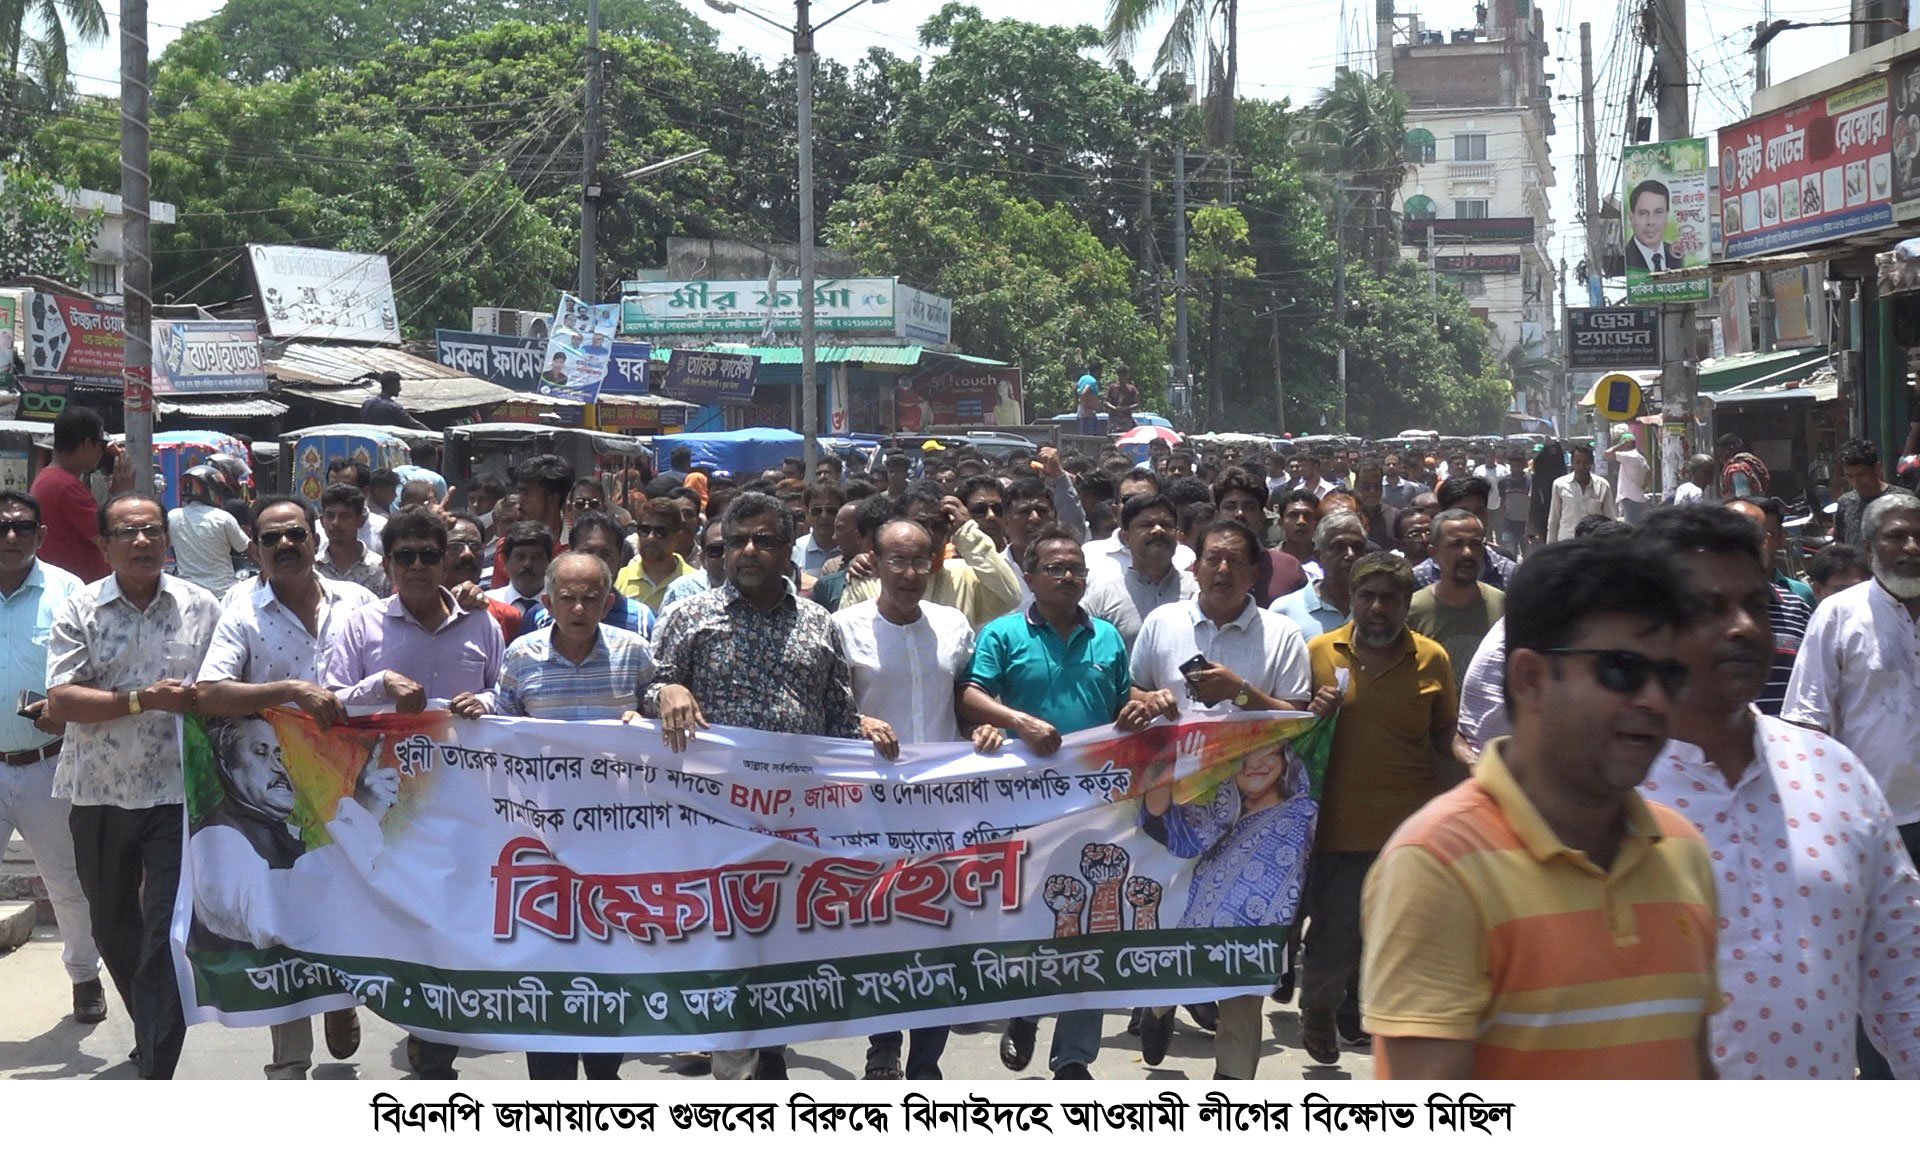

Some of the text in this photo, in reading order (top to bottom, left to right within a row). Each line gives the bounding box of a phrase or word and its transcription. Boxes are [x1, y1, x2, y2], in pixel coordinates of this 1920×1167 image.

[667, 281, 740, 311] মীর
[396, 736, 434, 775] খুনী
[440, 744, 498, 772] তারেক
[501, 753, 585, 785] রহমানের
[804, 783, 864, 810] জামাত
[870, 784, 886, 803] ও
[994, 768, 1071, 801] অপশক্তি
[573, 799, 673, 833] যোগাযোগ
[491, 837, 1027, 941] বিক্ষোভ মিছিল
[419, 976, 554, 1023] আওয়ামী
[561, 976, 632, 1025] লীগ
[643, 991, 669, 1021] ও
[680, 985, 740, 1021] অঙ্গ
[746, 963, 847, 1020] সহযোগী
[852, 951, 967, 1004] সংগঠন,
[971, 945, 1106, 992] ঝিনাইদহ
[1116, 940, 1197, 978] জেলা
